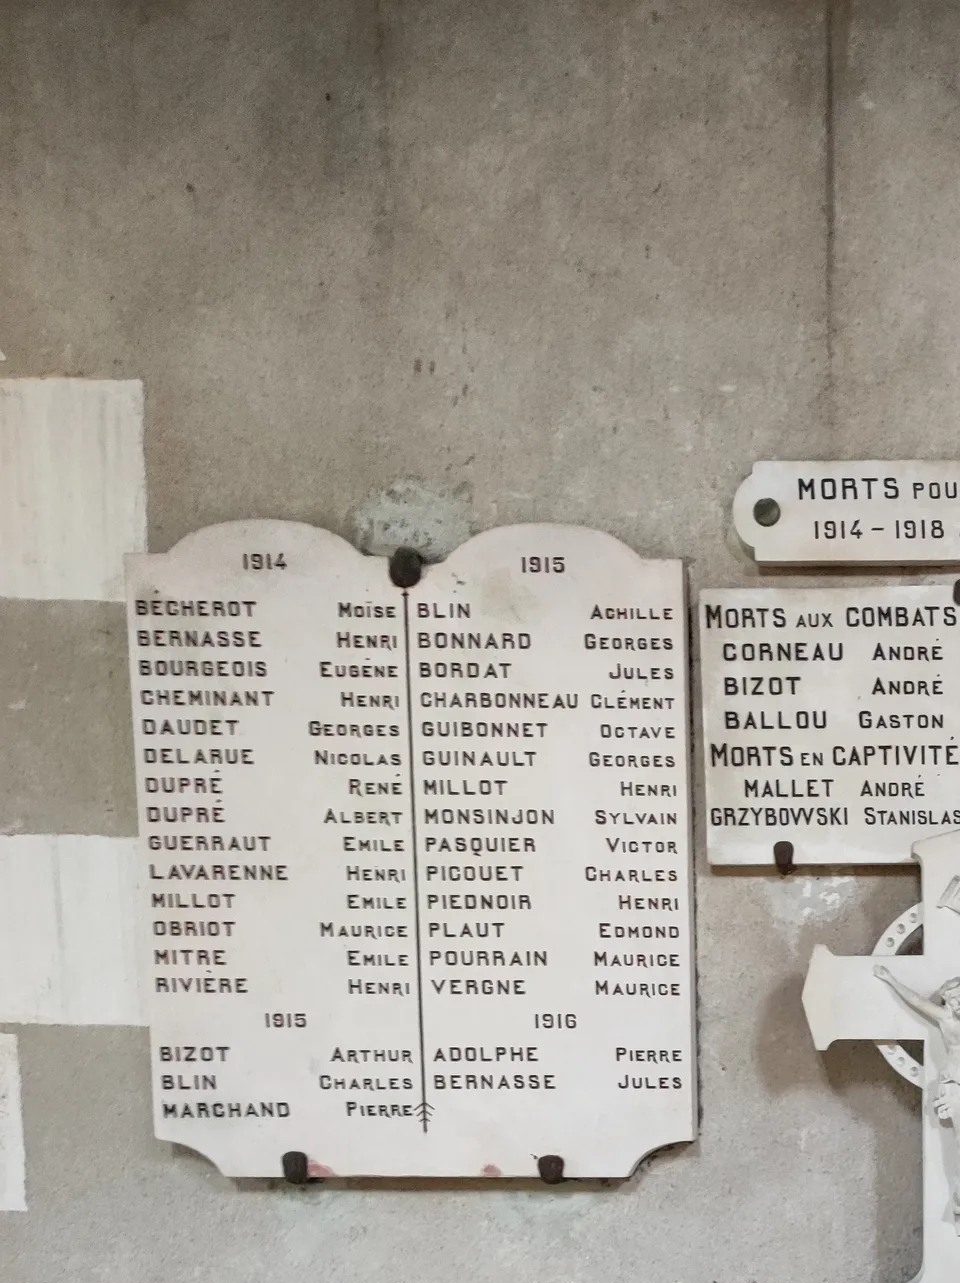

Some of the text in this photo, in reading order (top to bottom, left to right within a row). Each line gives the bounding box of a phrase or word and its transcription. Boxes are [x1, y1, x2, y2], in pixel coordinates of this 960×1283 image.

[797, 477, 900, 501] MORTS
[242, 552, 288, 571] 1914
[520, 556, 566, 574] 1915
[416, 602, 674, 621] BLIN ACHILLE
[705, 604, 958, 629] MORTS AUX COMBATS
[137, 629, 398, 651] BERNASSE HENRI
[722, 638, 944, 663] CORNEAU ANDRÉ
[418, 661, 675, 681] BORDAT JULES
[723, 673, 944, 697] BIZOT ANDRÉ
[420, 689, 676, 710] CHARBONNEAU CLÉMENT
[723, 710, 944, 730] BALLOU GASTON
[421, 721, 676, 740] GUIBONNET OCTAVE
[143, 747, 403, 767] DELARUE NICOLAS
[422, 750, 676, 769] GUINAULT GEORGES
[710, 735, 960, 768] MORTS EN CAPTIVITÉ
[744, 774, 926, 800] MALLET ANDRÉ
[424, 808, 677, 826] MONSINJON SYLVAIN
[424, 836, 678, 857] PASQUIER VICTOR
[148, 863, 406, 884] LAVARENNE HENRI
[151, 892, 407, 910] MILLOT EMILE
[426, 894, 679, 912] PIEDNOIR HENRI
[152, 920, 409, 940] OBRIOT MAURICE
[428, 922, 680, 939] PLAUT EDMOND
[428, 950, 681, 969] POURRAIN MAURICE
[430, 979, 681, 999] VERGNE MAURICE
[264, 1012, 308, 1029] 1915
[534, 1013, 577, 1030] 1916
[159, 1045, 414, 1064] BIZOT ARTHUR
[432, 1046, 683, 1065] ADOLPHE PIERRE
[161, 1074, 414, 1092] BLIN CHARLES
[433, 1074, 683, 1090] BERNASSE JULES
[162, 1101, 414, 1119] MARCHAND PIERRE
